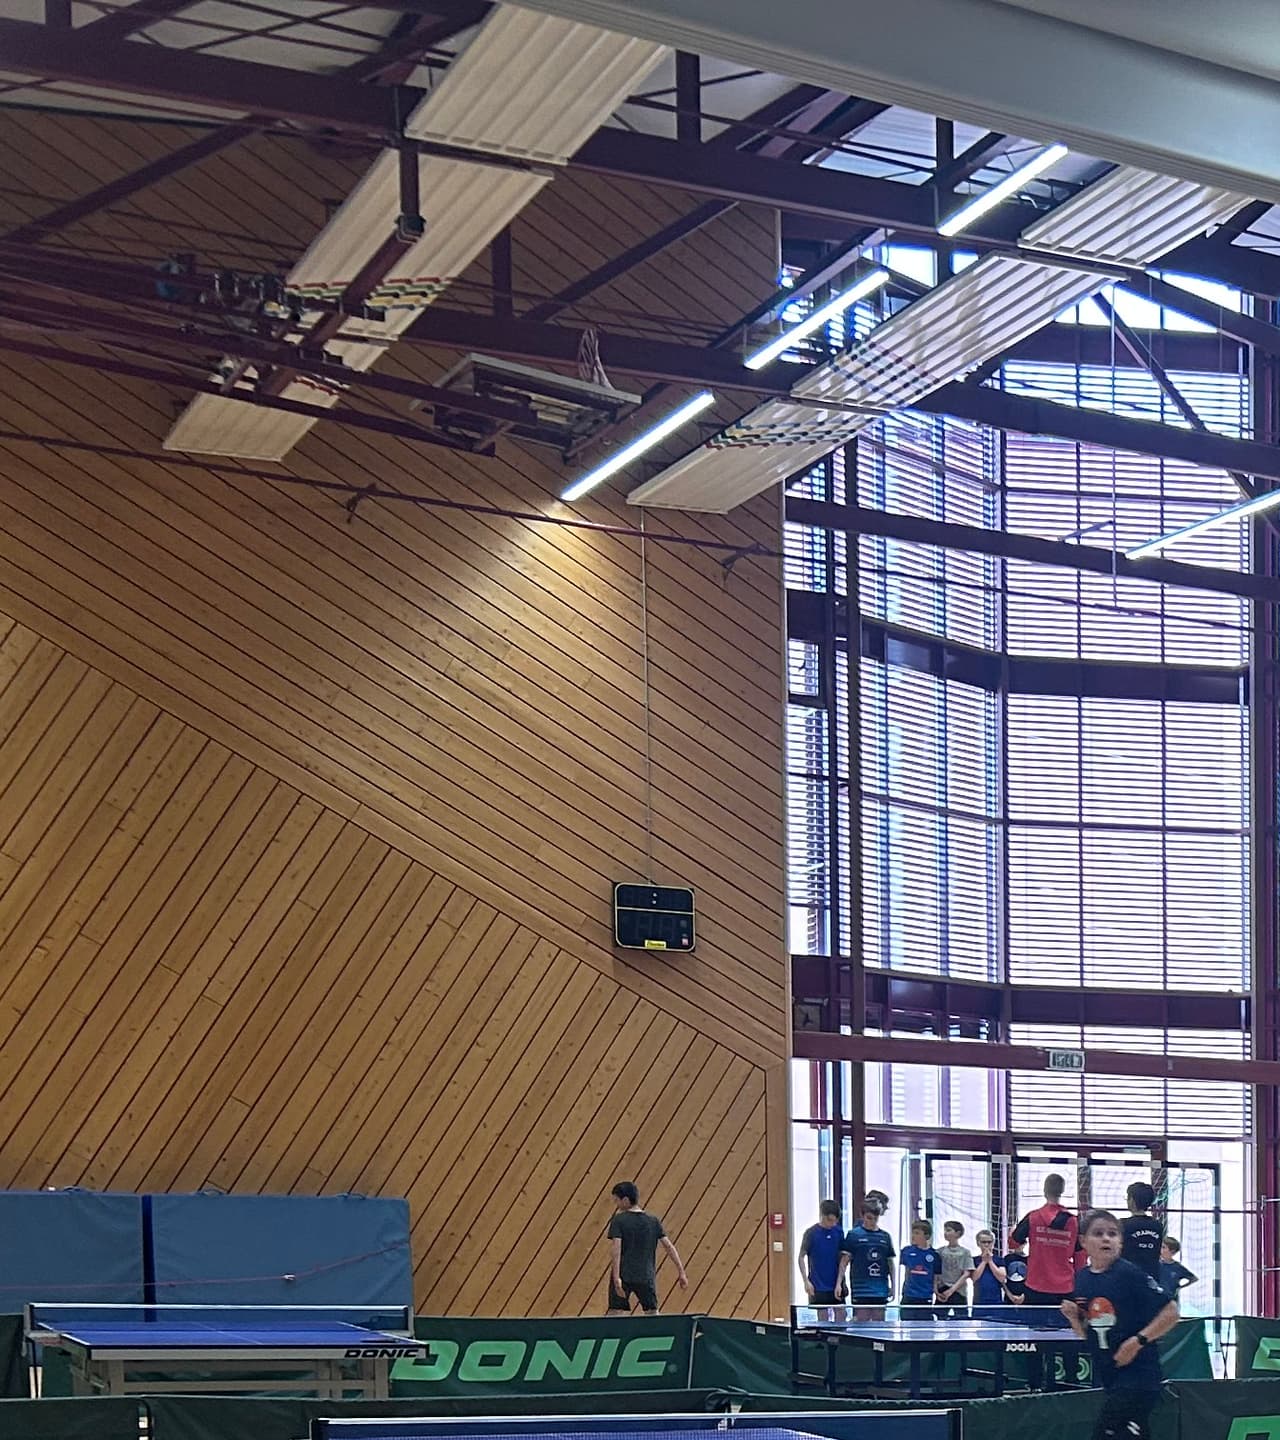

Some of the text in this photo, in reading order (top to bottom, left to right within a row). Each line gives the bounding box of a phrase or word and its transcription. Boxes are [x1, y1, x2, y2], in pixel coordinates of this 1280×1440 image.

[1006, 1343, 1037, 1351] JOOLA
[344, 1350, 419, 1358] DONIC
[389, 1336, 675, 1382] DONIC
